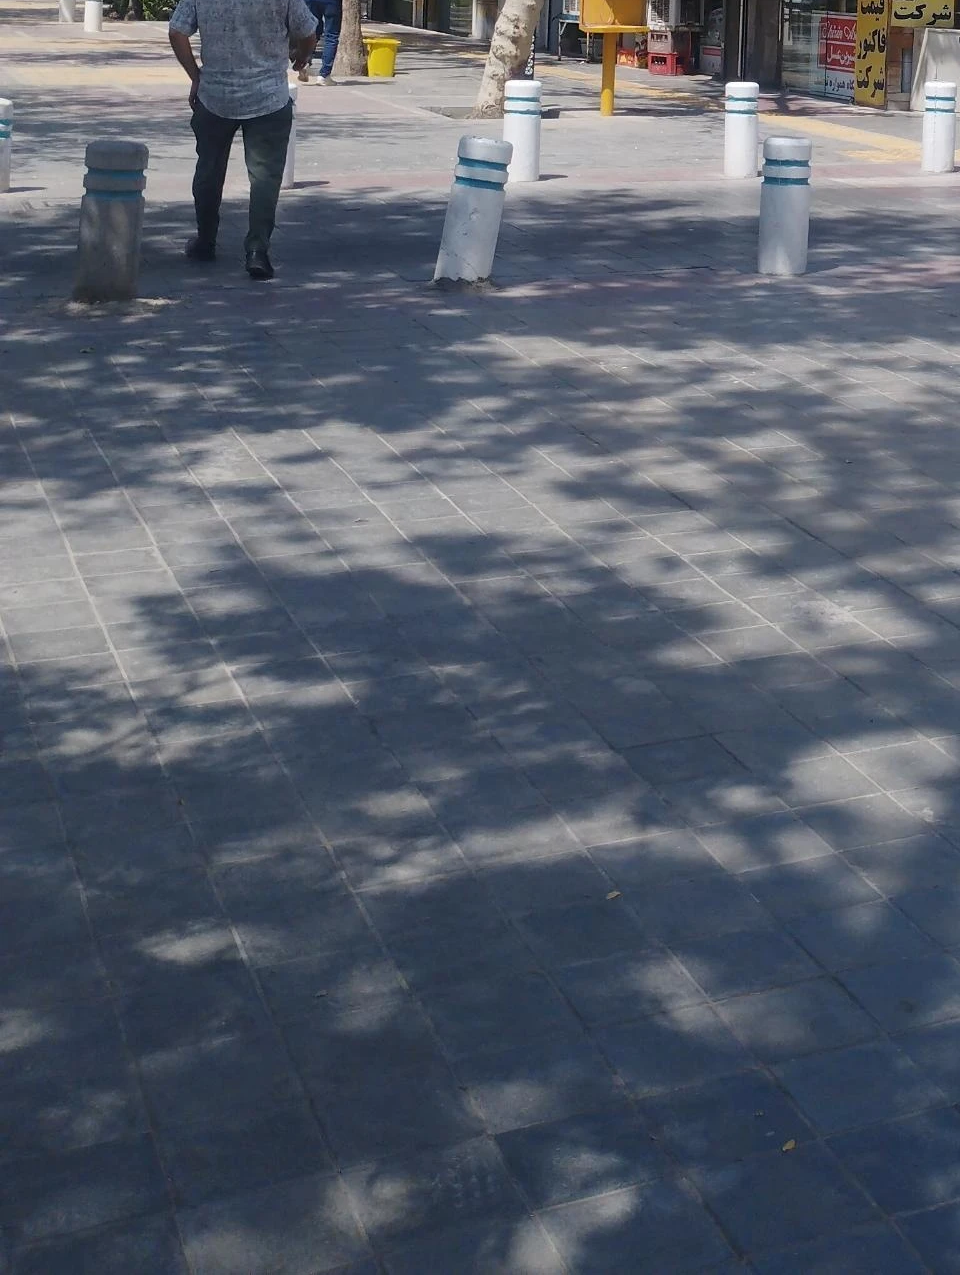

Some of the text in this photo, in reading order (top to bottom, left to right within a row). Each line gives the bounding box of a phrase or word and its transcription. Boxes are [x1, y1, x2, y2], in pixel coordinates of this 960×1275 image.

[893, 4, 952, 25] شرکت
[857, 27, 886, 59] فاکتور
[856, 66, 885, 98] شرکت
